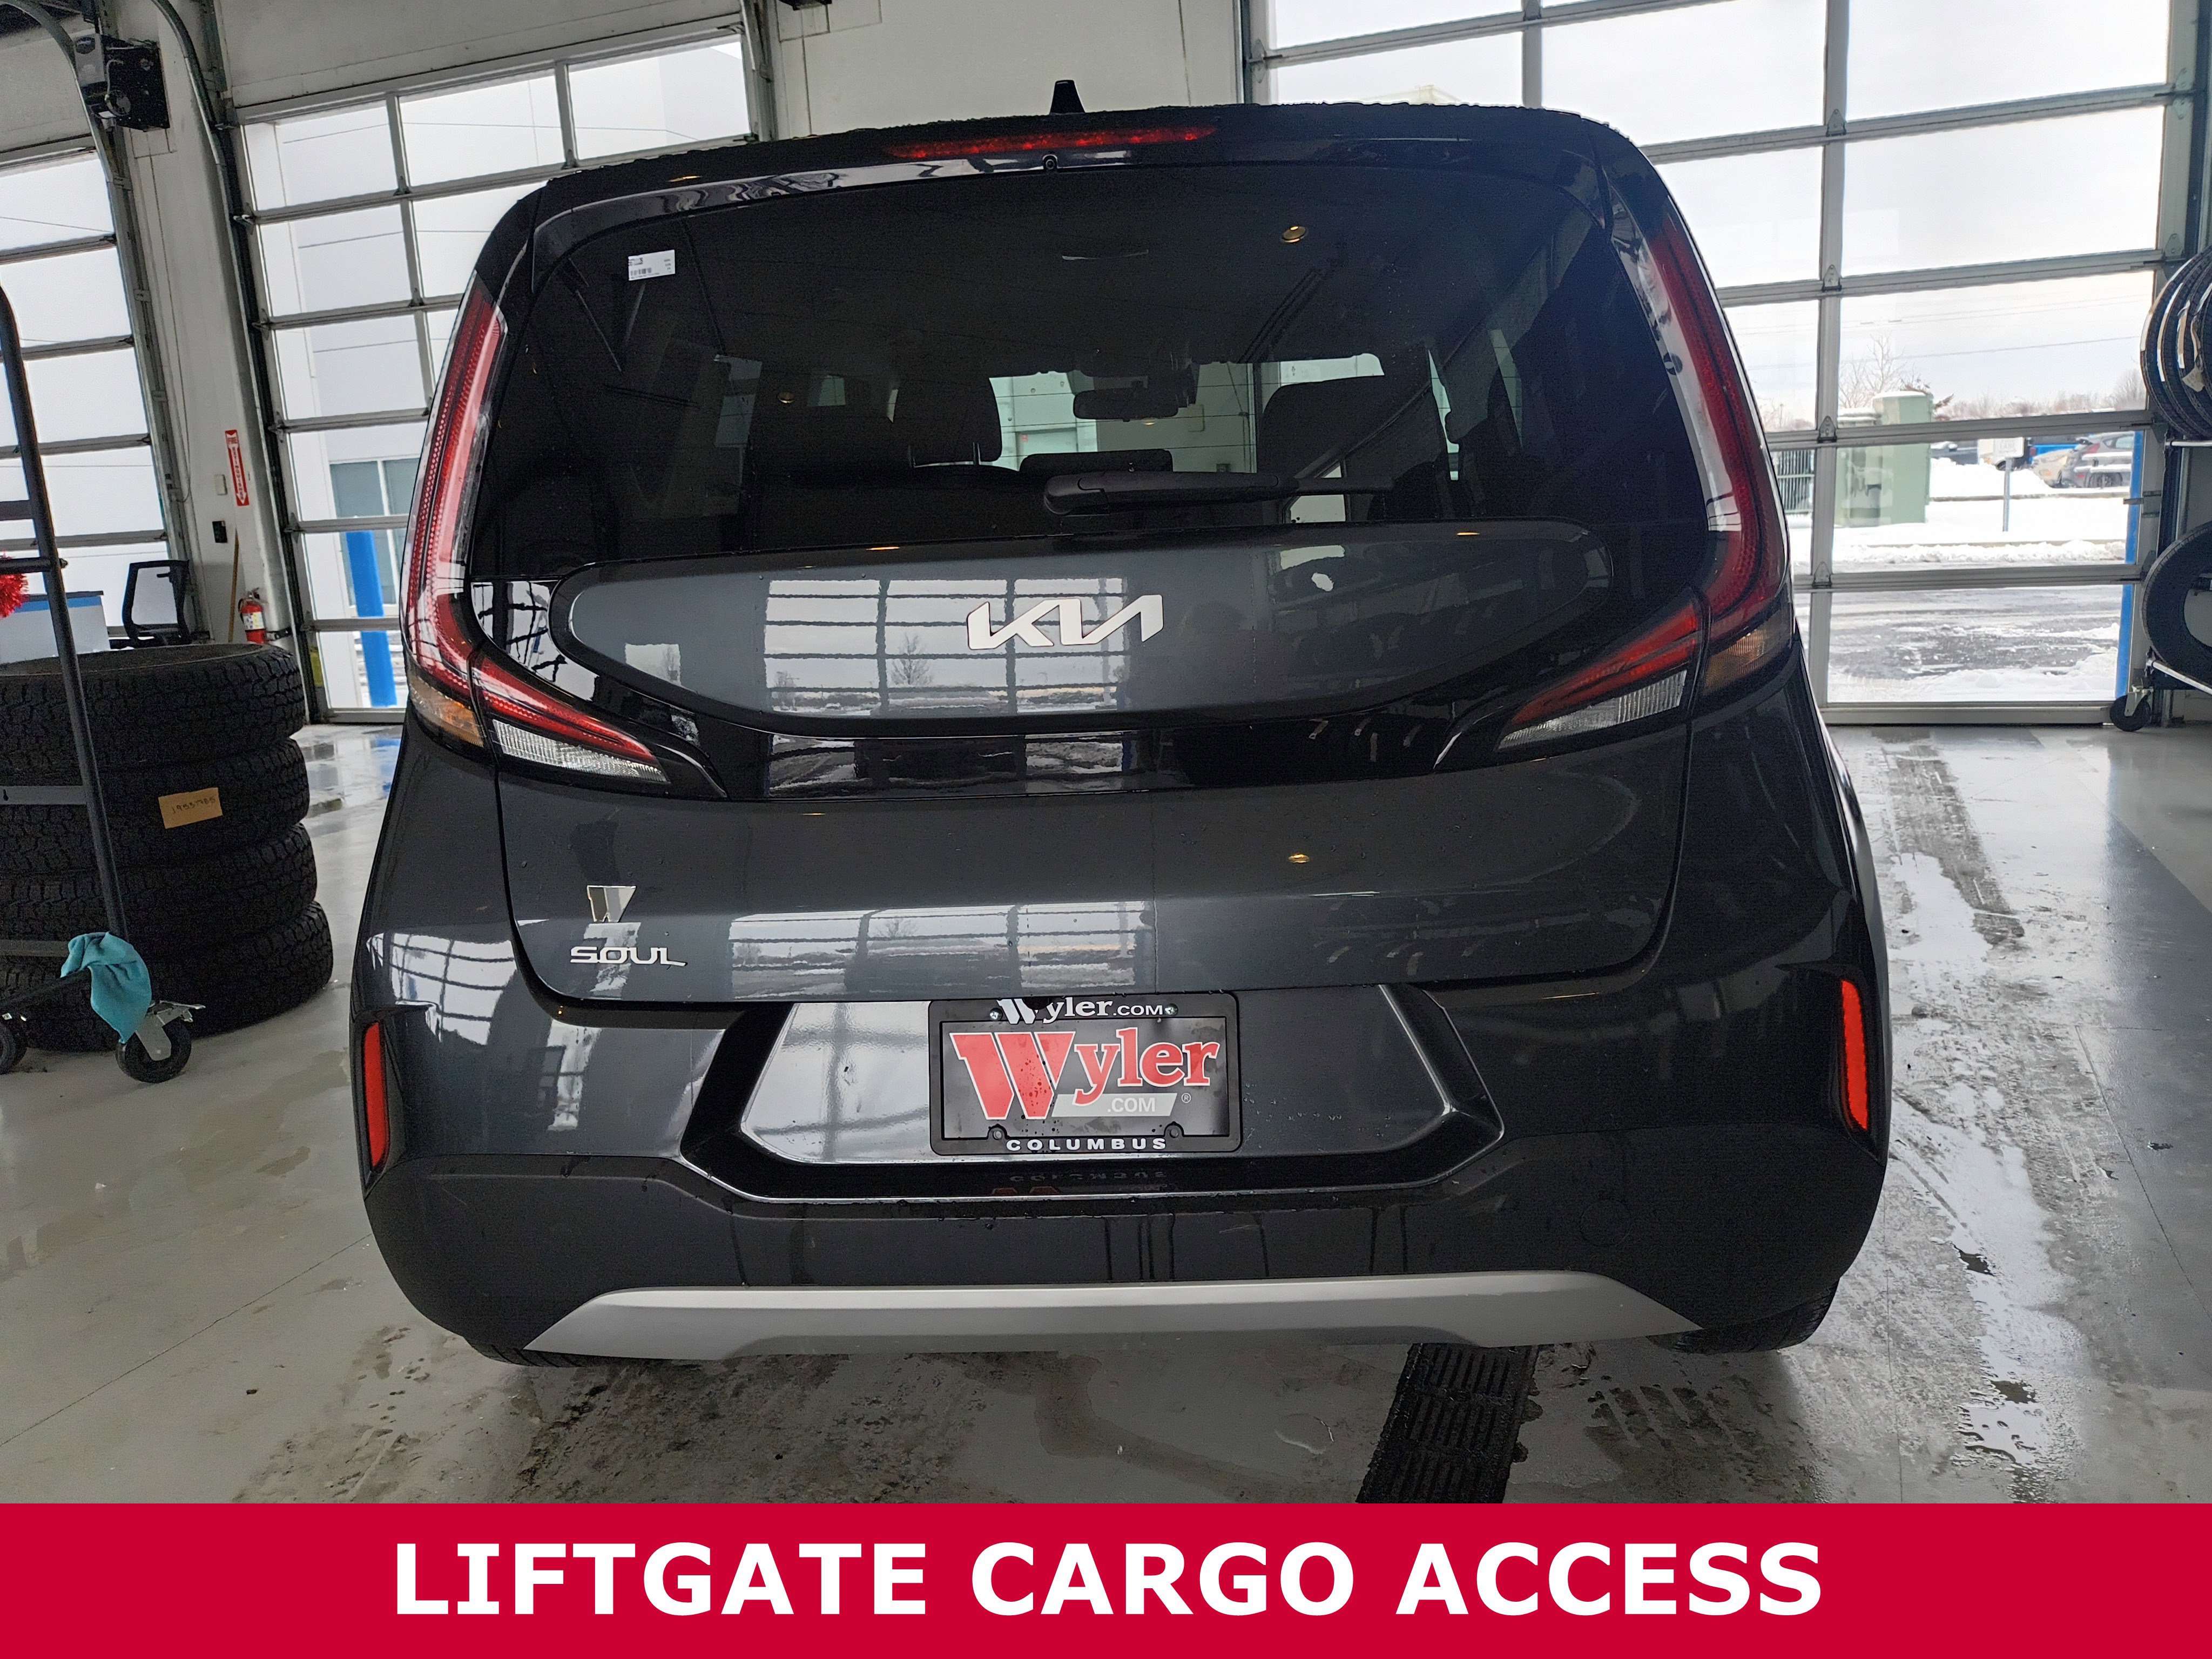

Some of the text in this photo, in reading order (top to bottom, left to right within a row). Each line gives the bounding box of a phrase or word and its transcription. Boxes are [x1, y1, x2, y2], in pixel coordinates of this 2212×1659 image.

[967, 594, 1164, 650] KIA
[570, 946, 687, 967] SOUL
[949, 1027, 1220, 1120] Wyler
[1006, 1137, 1166, 1151] COLUMBUS
